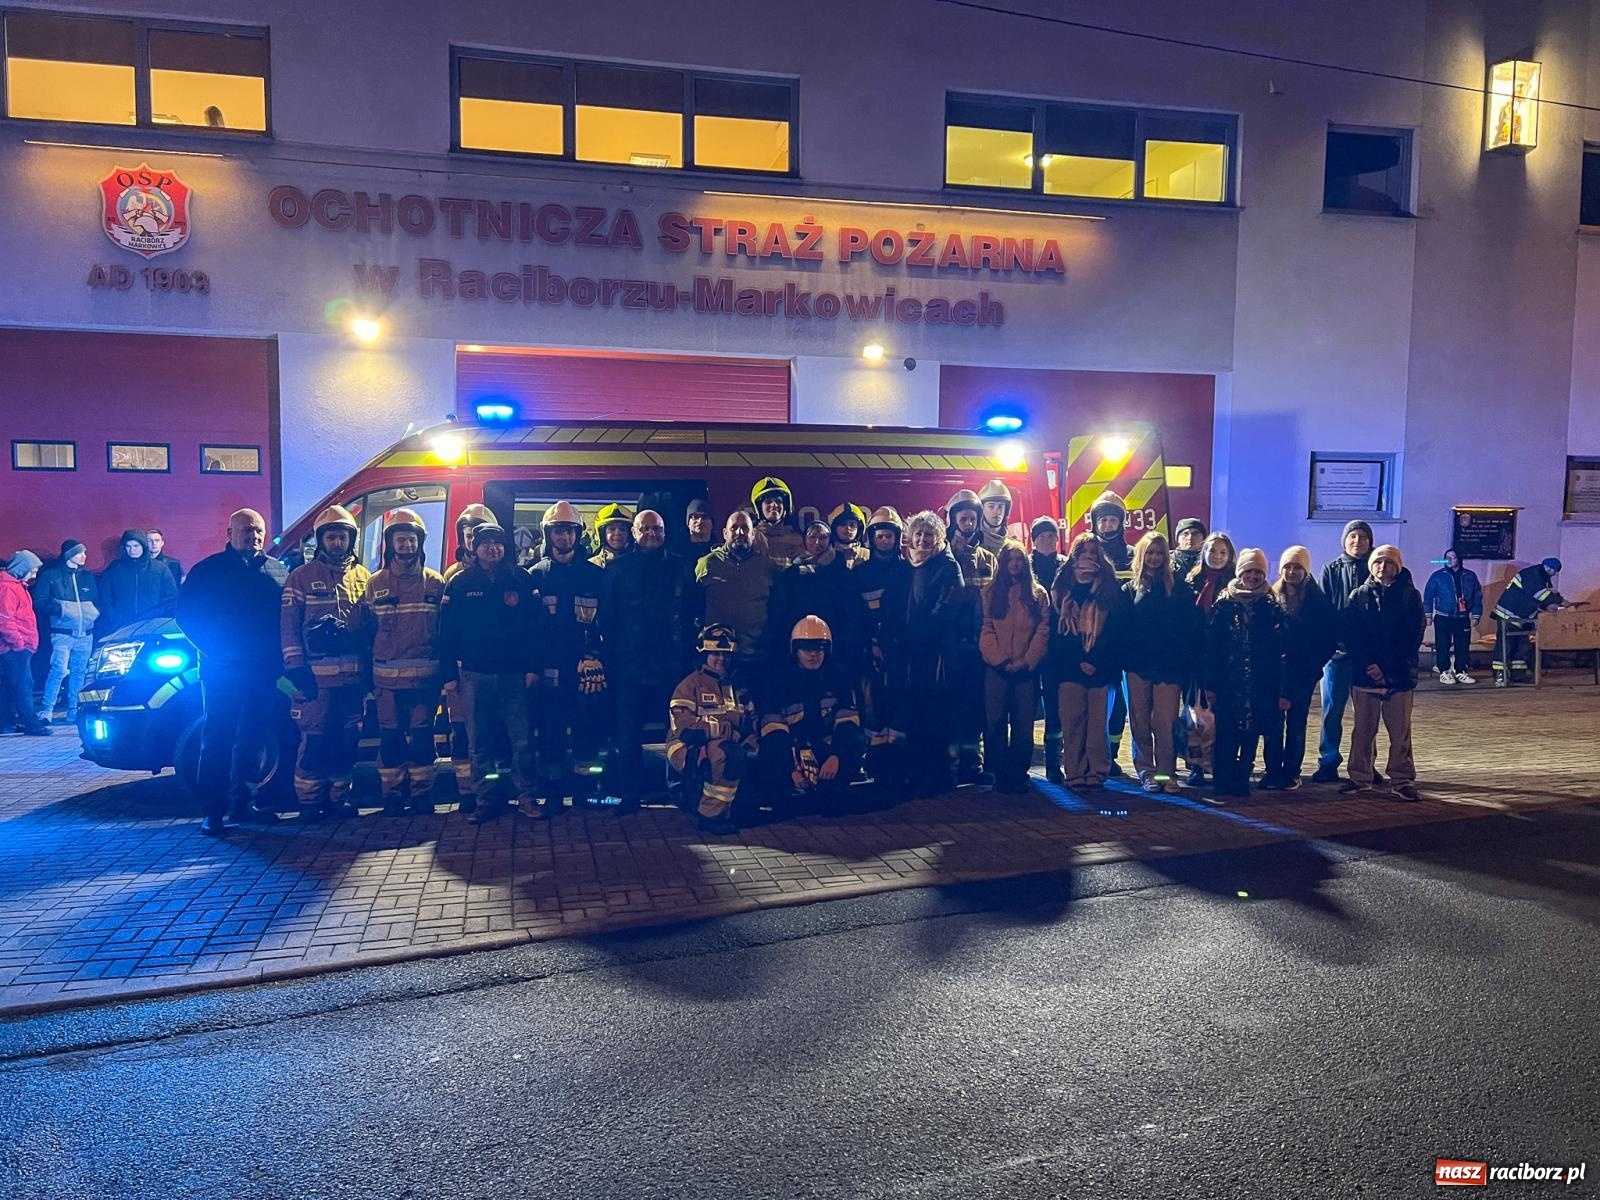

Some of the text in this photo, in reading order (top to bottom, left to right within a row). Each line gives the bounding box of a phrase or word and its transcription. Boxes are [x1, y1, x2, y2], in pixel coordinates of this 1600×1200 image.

[117, 171, 172, 188] OSP
[267, 185, 1066, 273] OCHOTNICZA STRAŻ POŻARNA
[86, 263, 210, 295] AD 1903
[352, 257, 1005, 327] w Raciborzu-Markowicach
